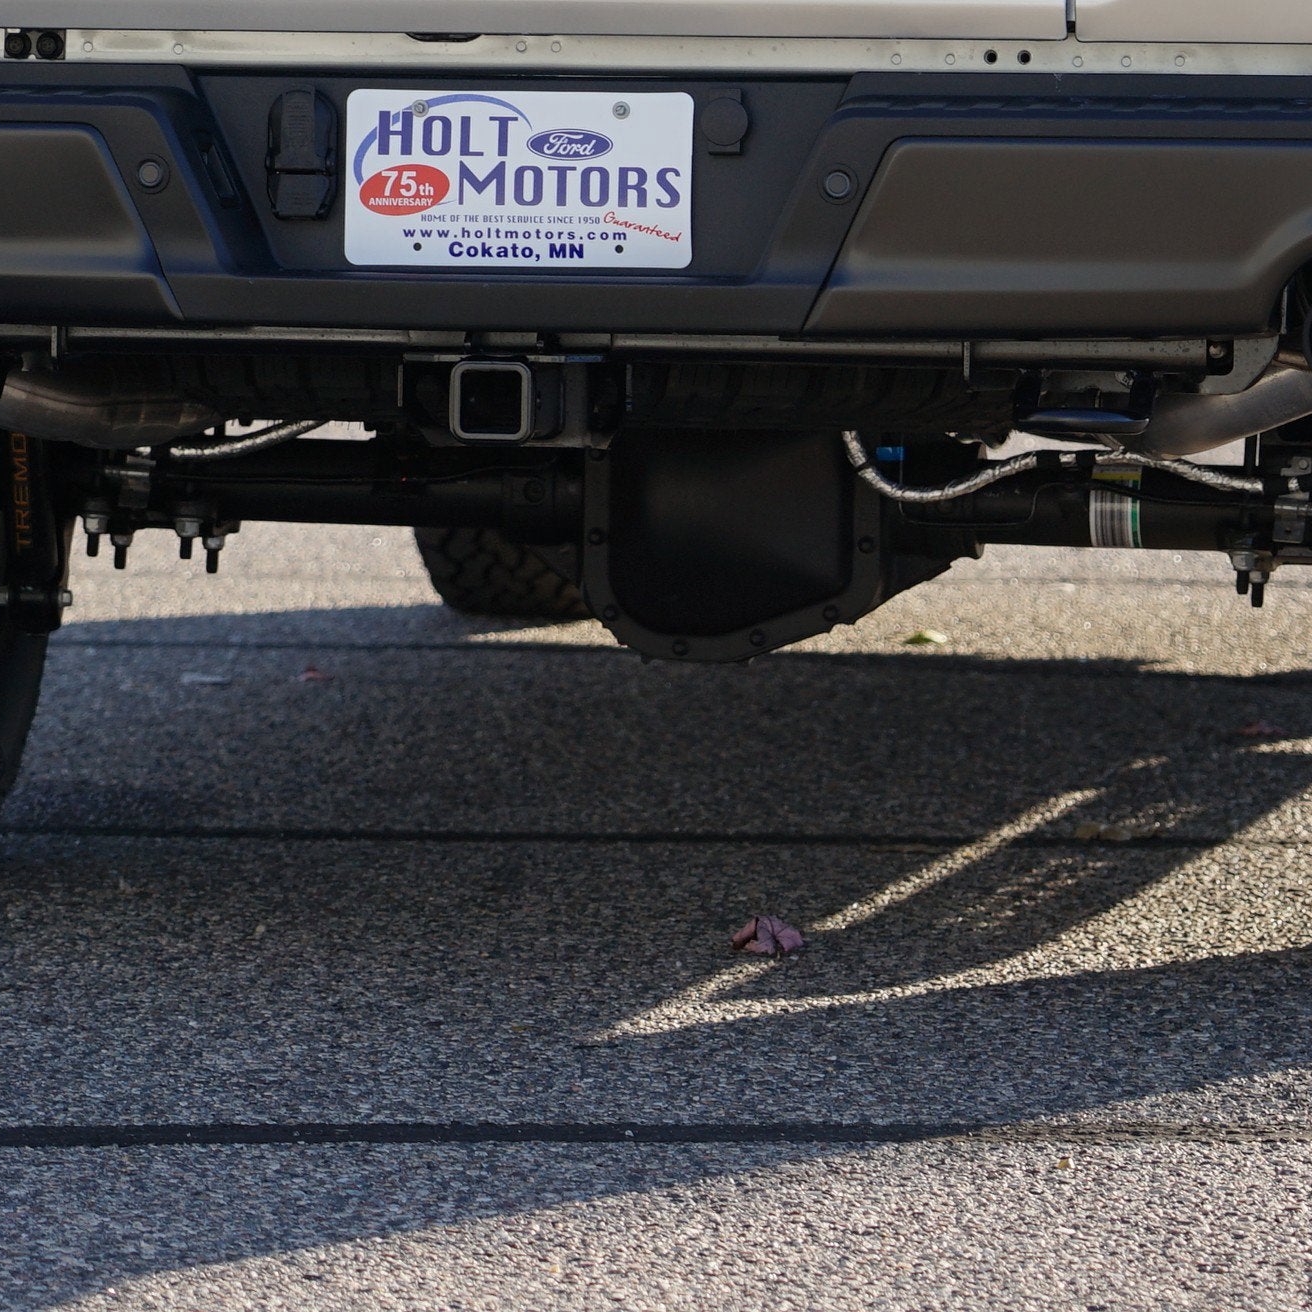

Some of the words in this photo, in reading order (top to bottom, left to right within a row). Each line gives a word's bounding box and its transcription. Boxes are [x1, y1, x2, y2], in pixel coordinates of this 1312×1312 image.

[377, 110, 519, 157] HOLT
[542, 130, 597, 159] Ford
[381, 170, 434, 197] 75th
[458, 160, 681, 209] MOTORS
[368, 197, 434, 207] ANNIVERSARY
[420, 214, 447, 223] HOME
[450, 214, 461, 223] OF
[464, 214, 480, 223] THE
[483, 215, 504, 224] BEST
[507, 215, 544, 224] SERVICE
[547, 215, 574, 224] SINCE
[577, 216, 601, 225] 1950
[602, 210, 683, 243] Guaranteed
[403, 227, 628, 242] www.holtmotors.com
[448, 241, 541, 262] Cokato,
[548, 242, 585, 259] MN
[11, 432, 31, 552] TREMO
